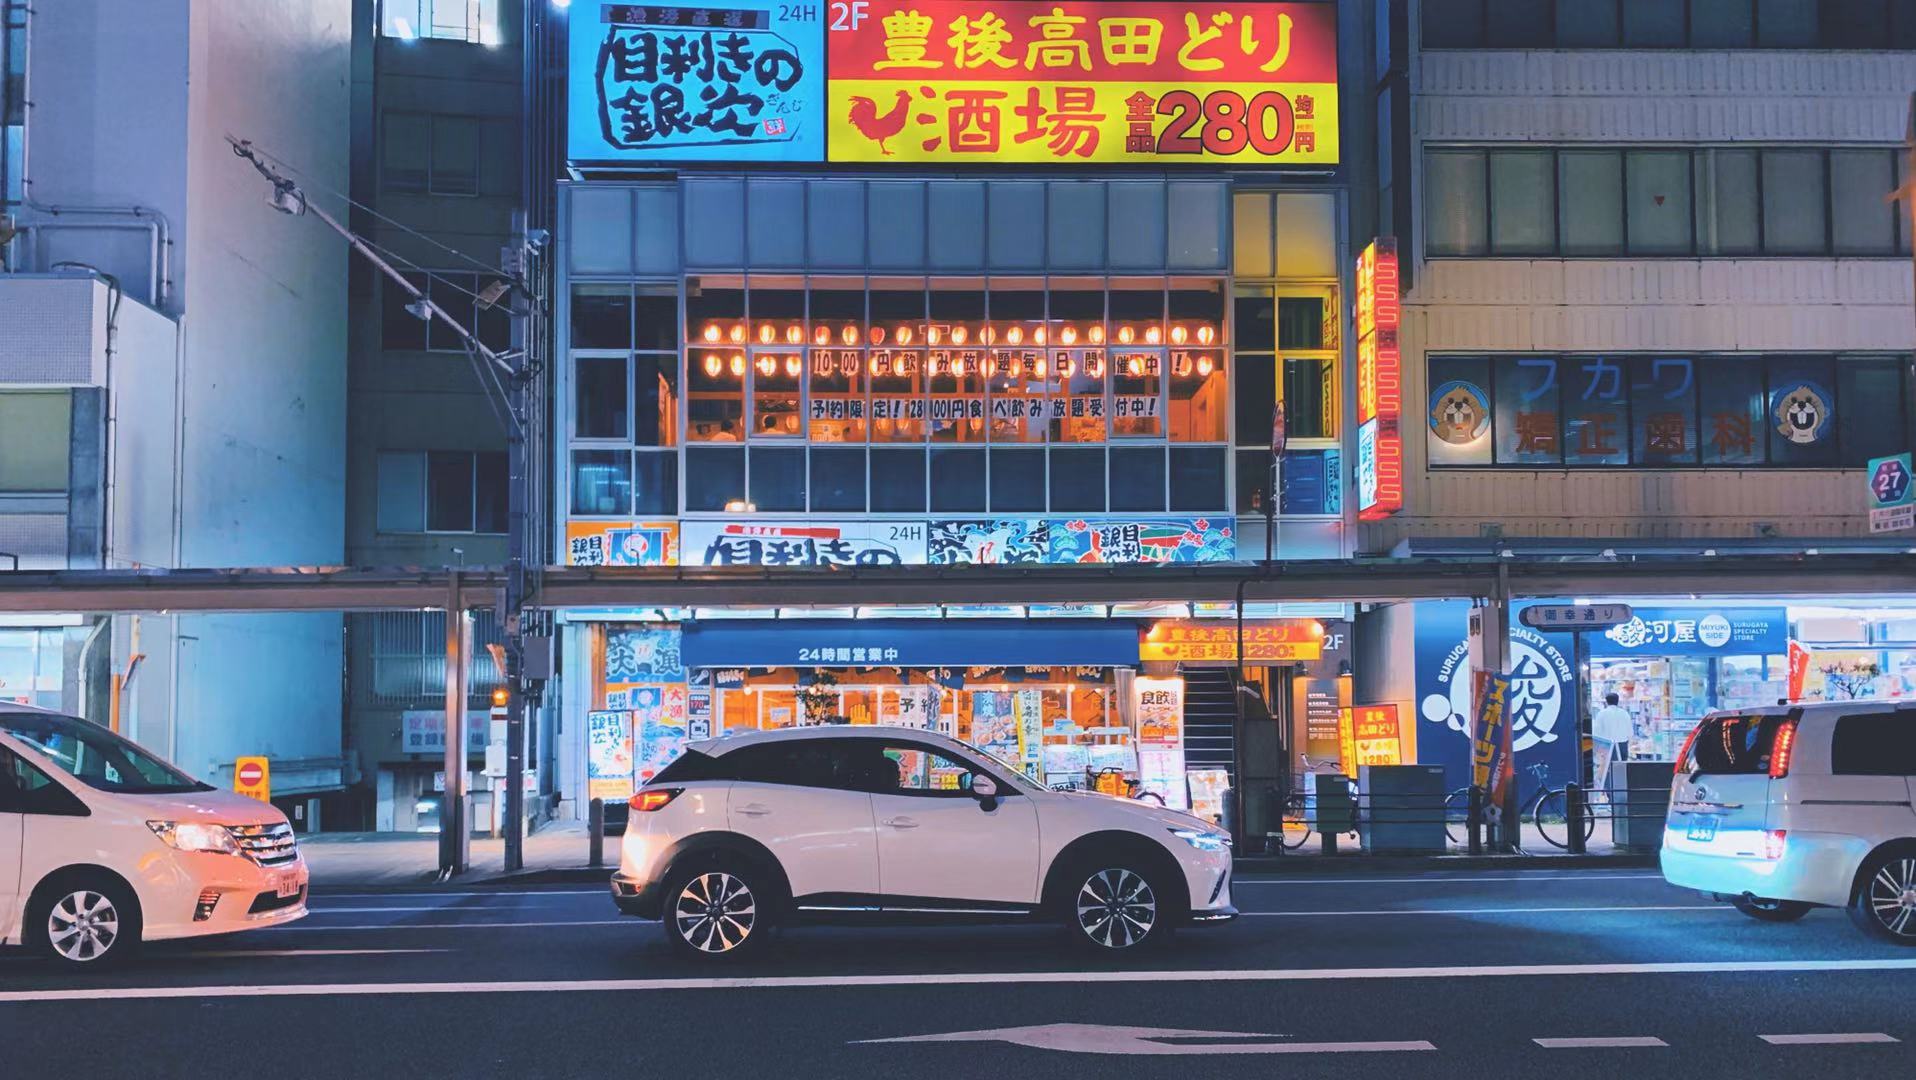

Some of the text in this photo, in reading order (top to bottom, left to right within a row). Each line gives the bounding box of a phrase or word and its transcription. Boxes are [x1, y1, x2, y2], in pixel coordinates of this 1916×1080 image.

[778, 5, 816, 22] 24H
[830, 2, 869, 31] 2F
[873, 8, 1293, 73] 豊後高田どり
[611, 31, 803, 92] 目利きの
[609, 84, 765, 143] 銀次
[920, 86, 1107, 158] 酒場
[1156, 89, 1295, 156] 280
[1517, 356, 1693, 400] フカワ
[1515, 411, 1757, 456] 矯正歯科
[1879, 471, 1901, 491] 27
[890, 525, 922, 542] 24H
[1122, 525, 1141, 561] 目利
[1323, 634, 1344, 650] 2F
[1618, 617, 1697, 645] 駿河屋
[1706, 632, 1724, 640] SIDE
[799, 647, 899, 662] 24時間営業中
[1509, 626, 1548, 649] CIALTY
[1545, 646, 1572, 683] STORE
